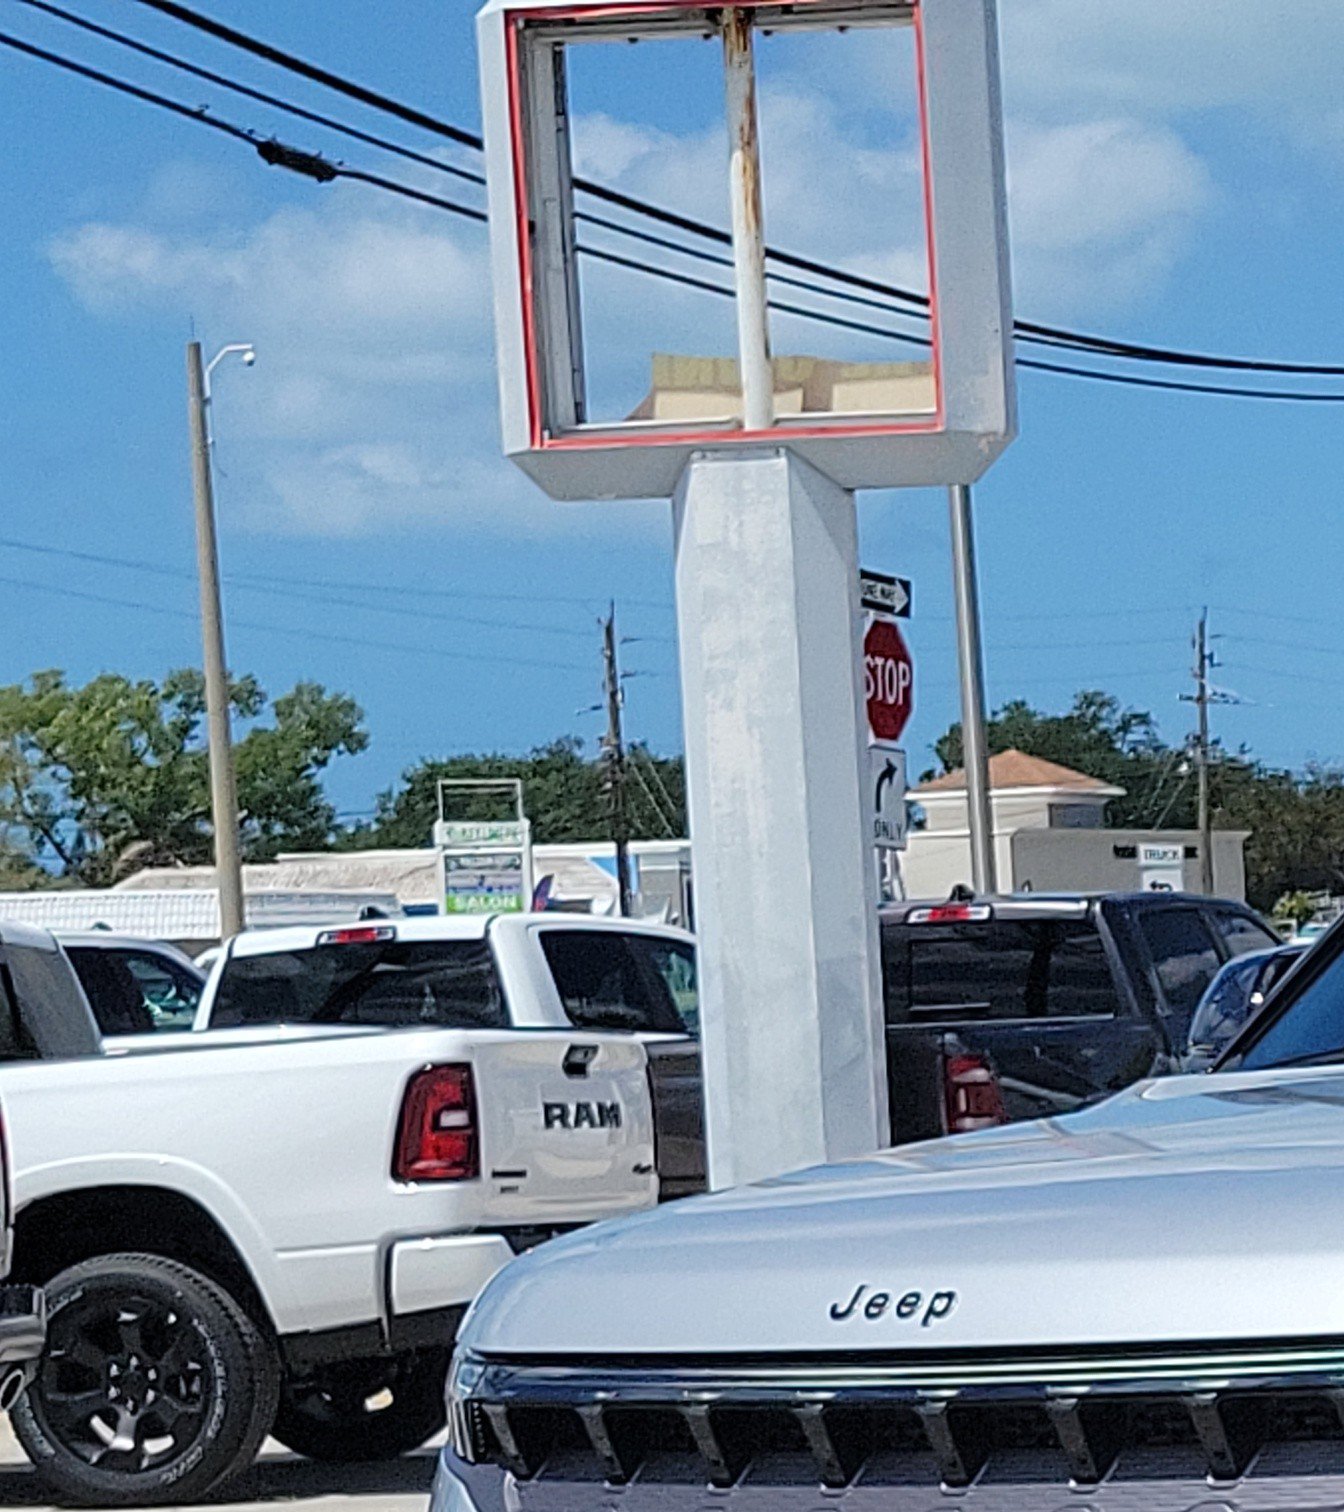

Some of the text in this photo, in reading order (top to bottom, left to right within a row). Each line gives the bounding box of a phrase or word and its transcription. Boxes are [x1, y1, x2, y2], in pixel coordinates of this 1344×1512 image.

[865, 655, 909, 706] STOP
[874, 818, 903, 841] ONLY
[542, 1101, 622, 1129] RAM
[829, 1284, 957, 1327] Jeep
